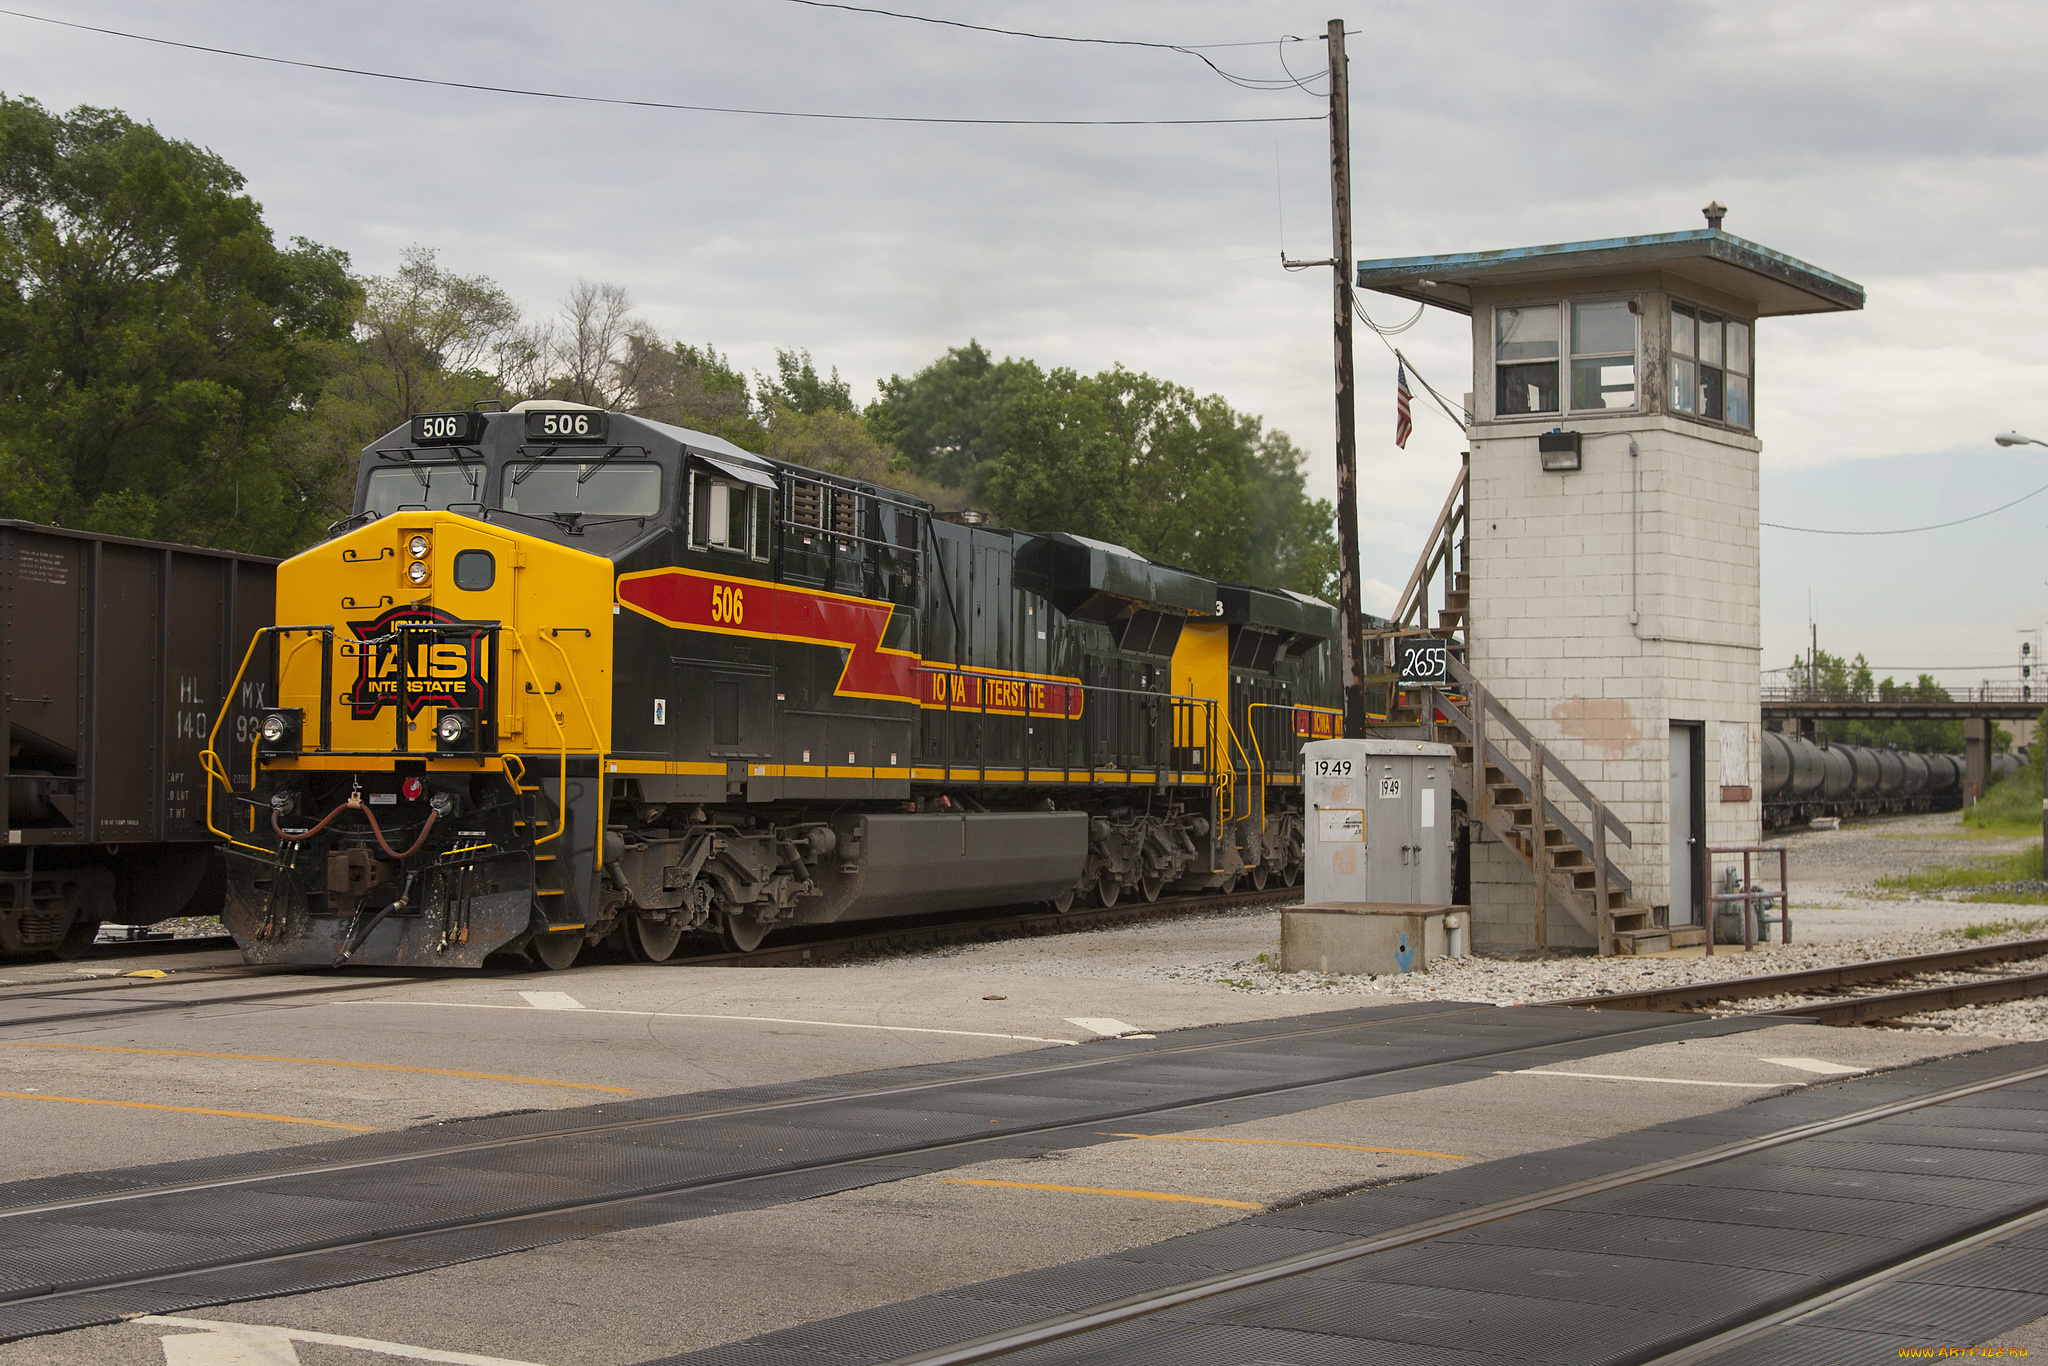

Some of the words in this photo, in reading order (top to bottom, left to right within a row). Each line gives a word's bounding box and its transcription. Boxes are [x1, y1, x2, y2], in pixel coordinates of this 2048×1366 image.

[423, 417, 457, 437] 506
[543, 414, 589, 434] 506
[711, 584, 744, 625] 506
[367, 643, 468, 678] IAIS
[1402, 648, 1446, 677] 2655
[177, 710, 207, 739] 140
[1315, 761, 1352, 776] 19.49
[1381, 780, 1400, 796] 19.49
